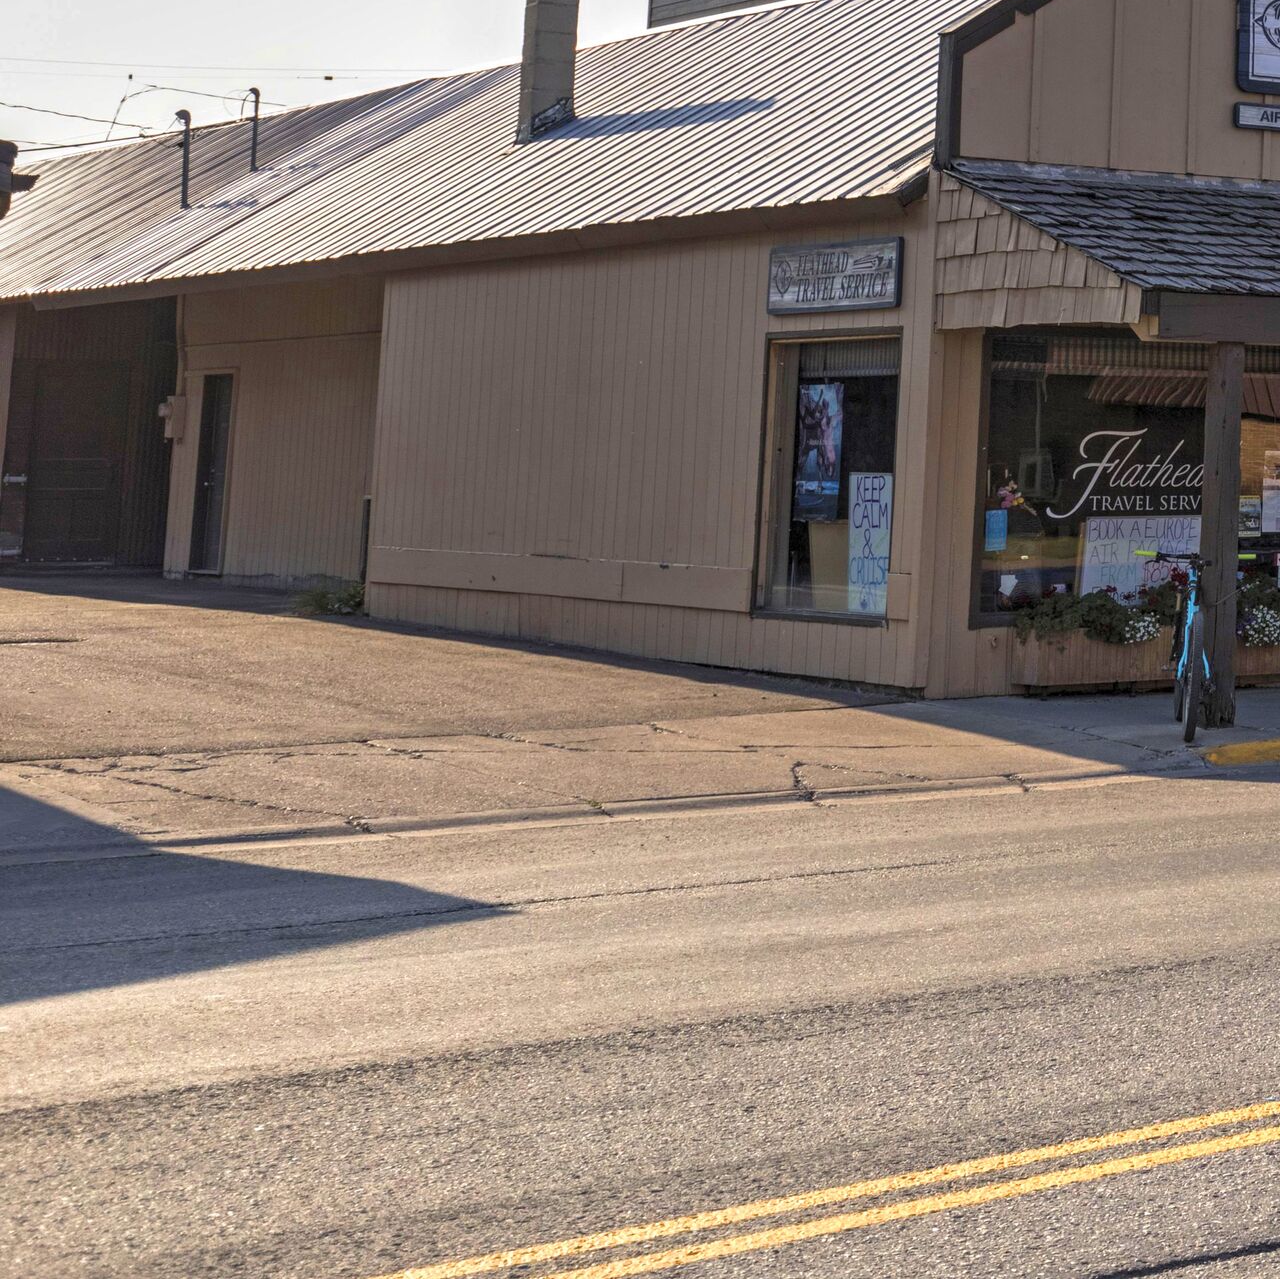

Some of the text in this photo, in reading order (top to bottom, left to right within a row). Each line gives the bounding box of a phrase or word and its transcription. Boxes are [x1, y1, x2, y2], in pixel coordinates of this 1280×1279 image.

[796, 251, 849, 277] FLATHEAD
[795, 271, 890, 303] TRAVEL SERVICE
[1046, 428, 1204, 518] Flathea
[856, 475, 886, 503] KEEP
[852, 502, 889, 529] CALM
[1089, 495, 1201, 511] TRAVEL SERV
[862, 528, 875, 559] &
[1087, 517, 1199, 543] BOOK A EUROPE
[1089, 543, 1120, 564] AIR
[850, 556, 889, 585] CRUISE
[1100, 562, 1137, 584] FROM
